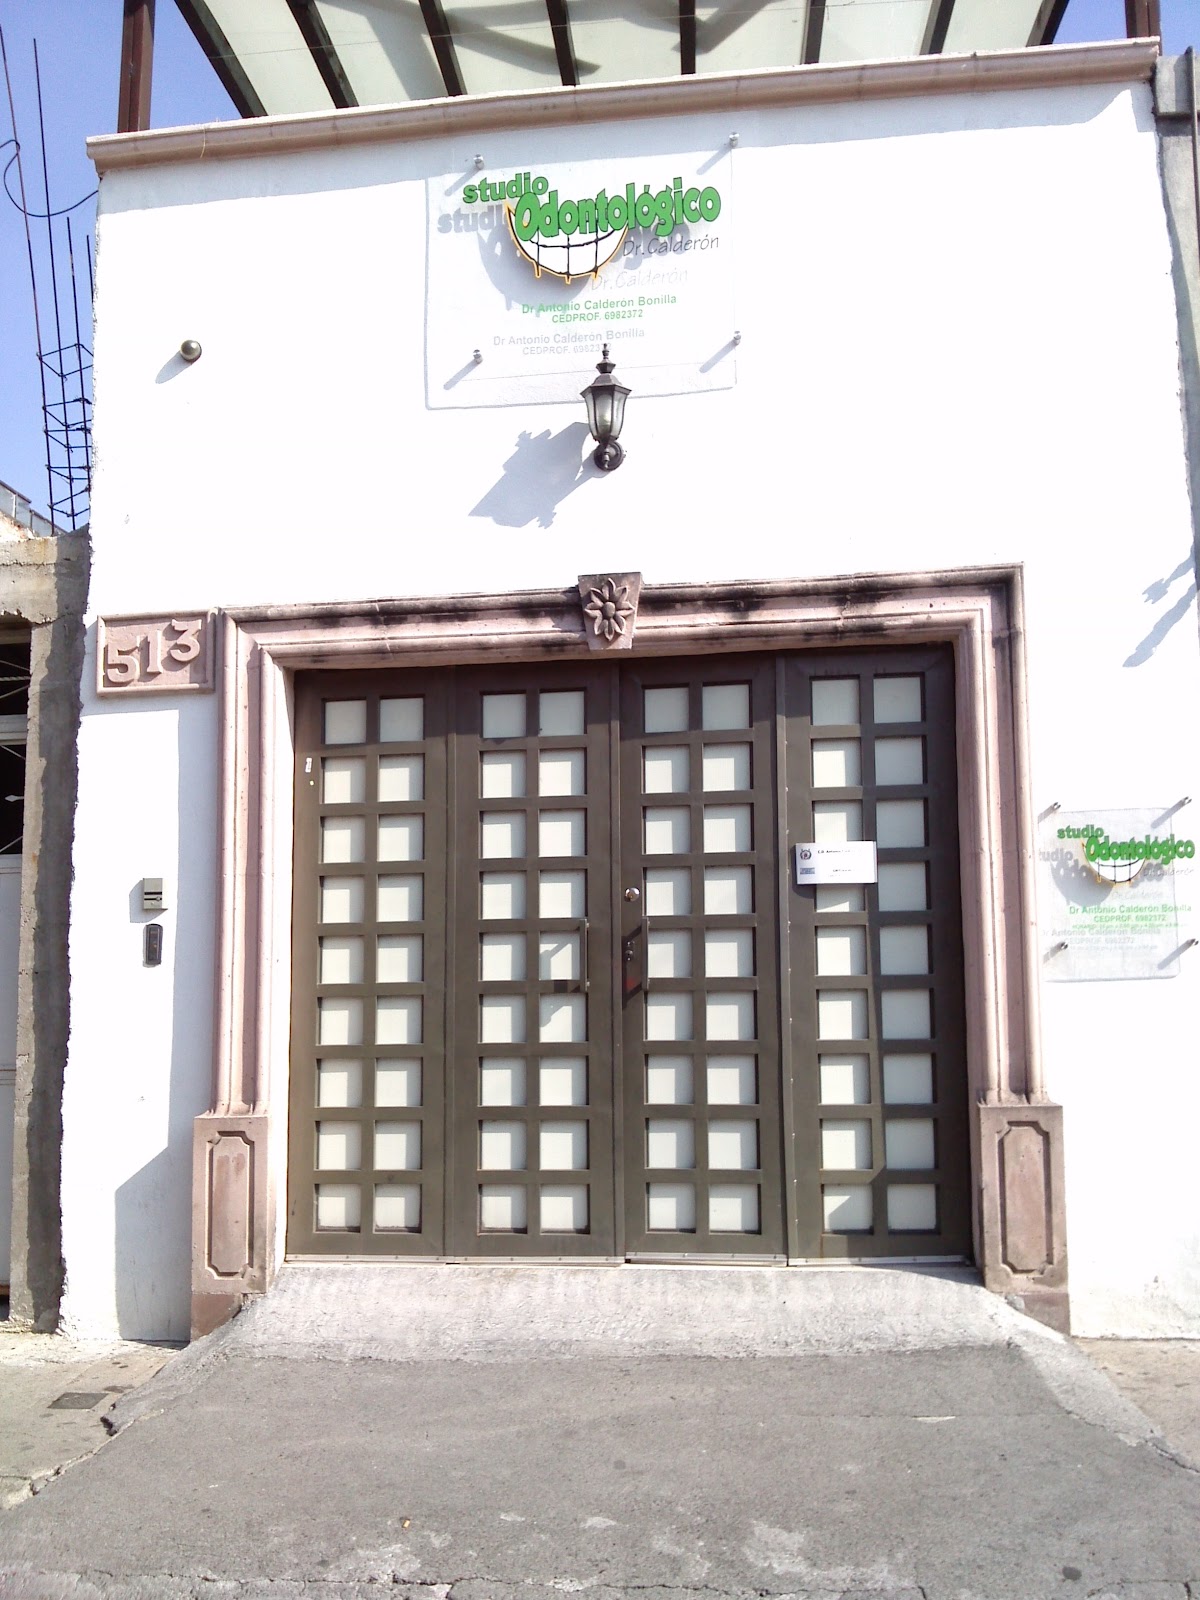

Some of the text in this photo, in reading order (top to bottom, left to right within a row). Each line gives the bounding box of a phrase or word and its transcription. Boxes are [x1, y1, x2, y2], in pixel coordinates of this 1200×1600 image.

[462, 172, 549, 204] studio
[515, 177, 721, 241] Odontológico
[522, 303, 534, 314] Dr
[537, 301, 581, 313] Antonio
[638, 294, 677, 306] Bonilla
[604, 309, 643, 320] 6982372
[107, 619, 202, 684] 513
[1057, 824, 1104, 839] studio
[1082, 905, 1117, 914] Antonio
